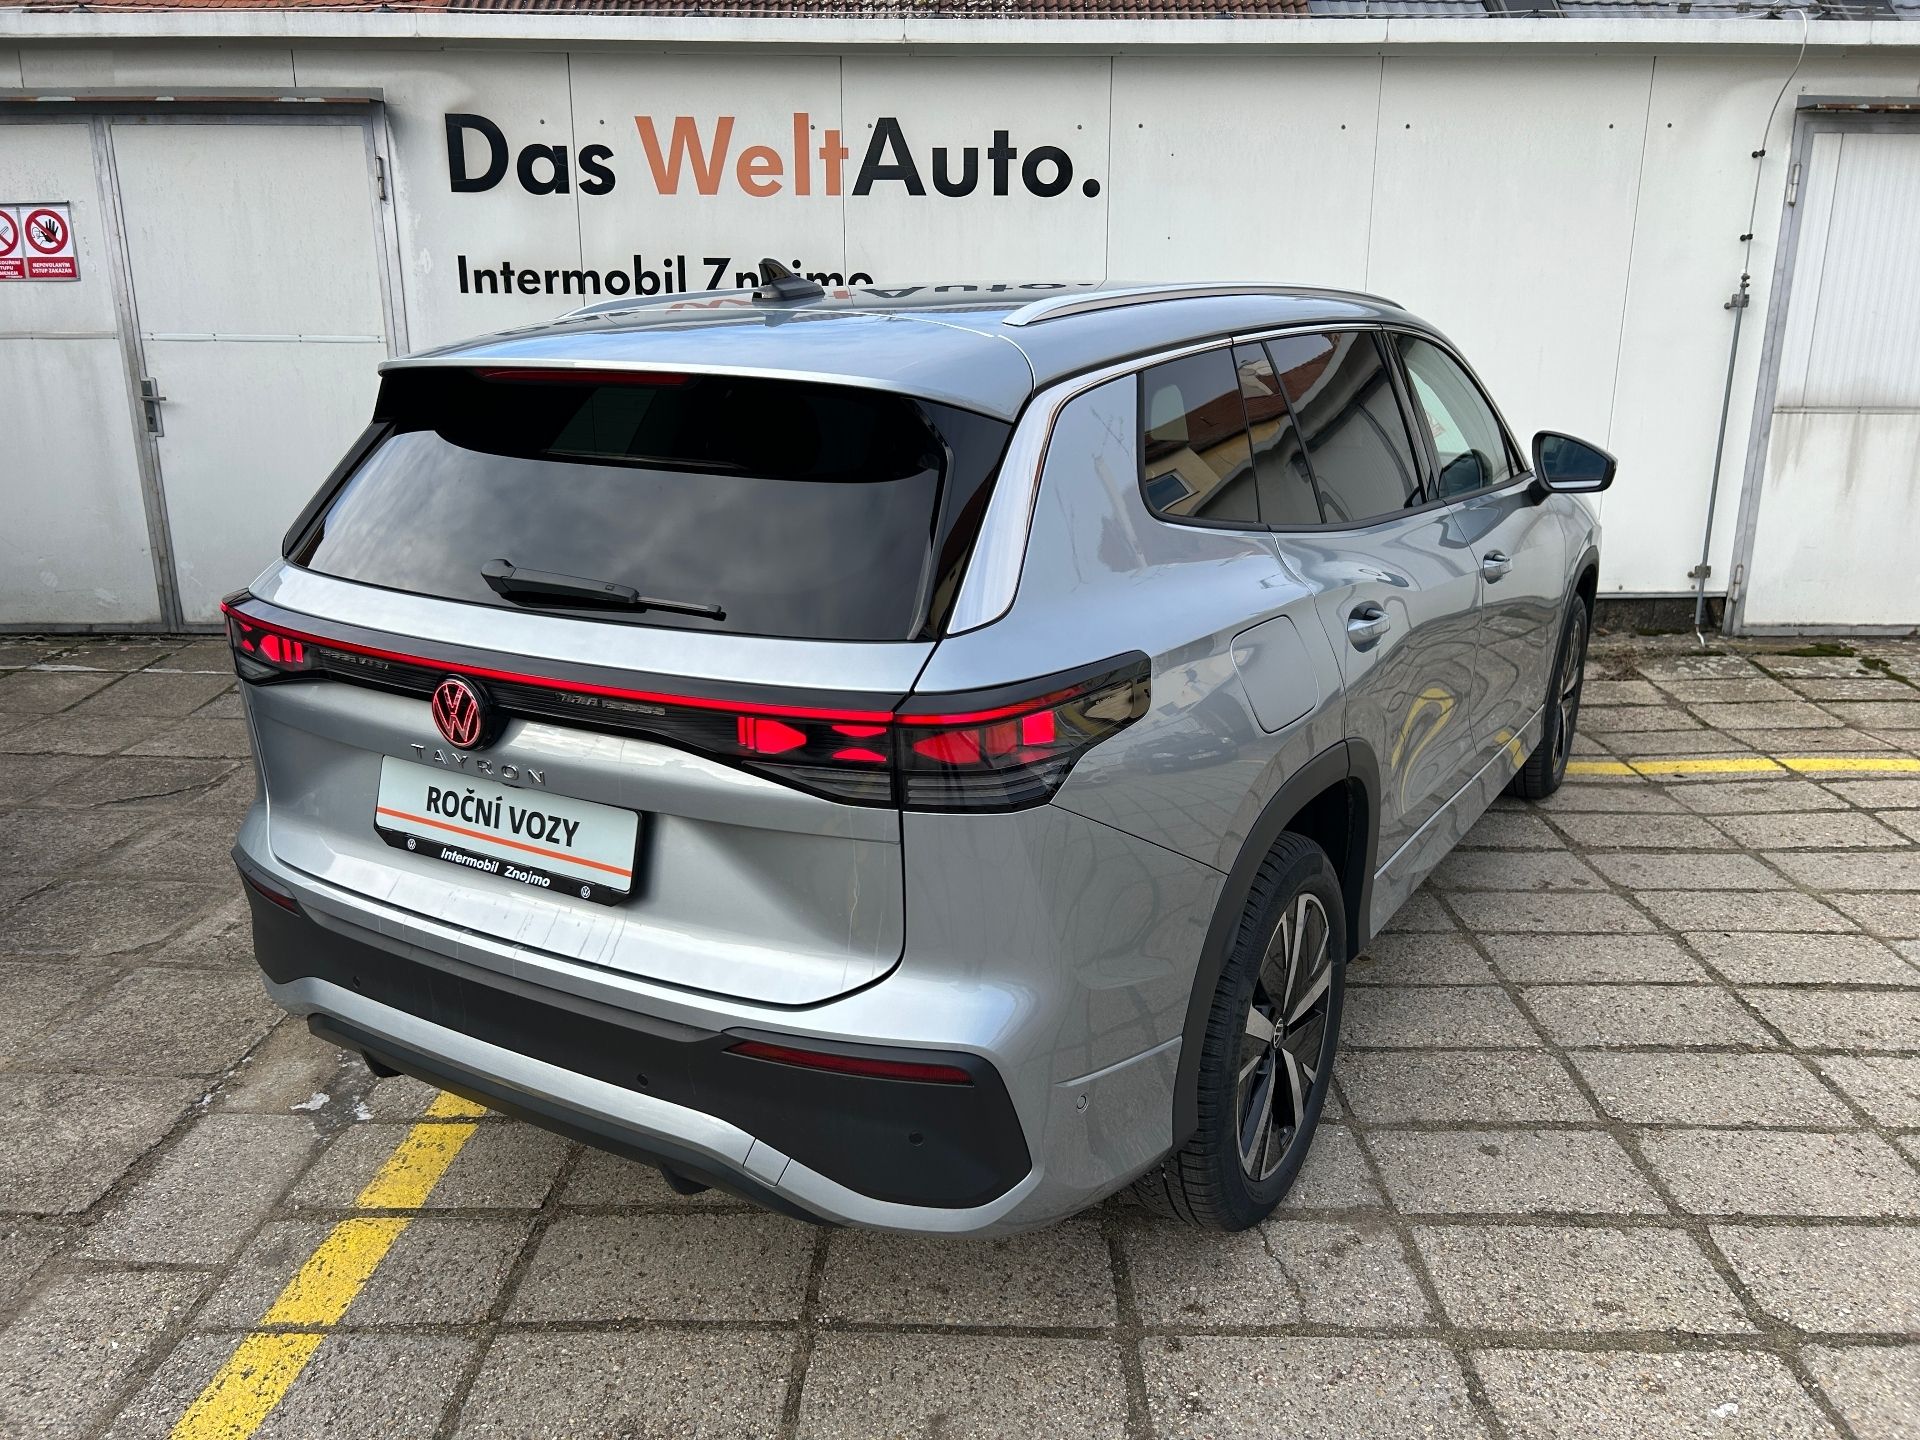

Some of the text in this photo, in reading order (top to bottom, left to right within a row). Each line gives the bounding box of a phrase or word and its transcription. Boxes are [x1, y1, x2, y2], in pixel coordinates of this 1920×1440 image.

[445, 112, 1101, 197] Das WeltAuto.
[457, 254, 874, 295] Intermobil Znmo
[411, 743, 546, 786] TAYRON
[426, 785, 580, 848] ROČNÍ VOZY
[440, 847, 551, 888] Intermobil Znojmo
